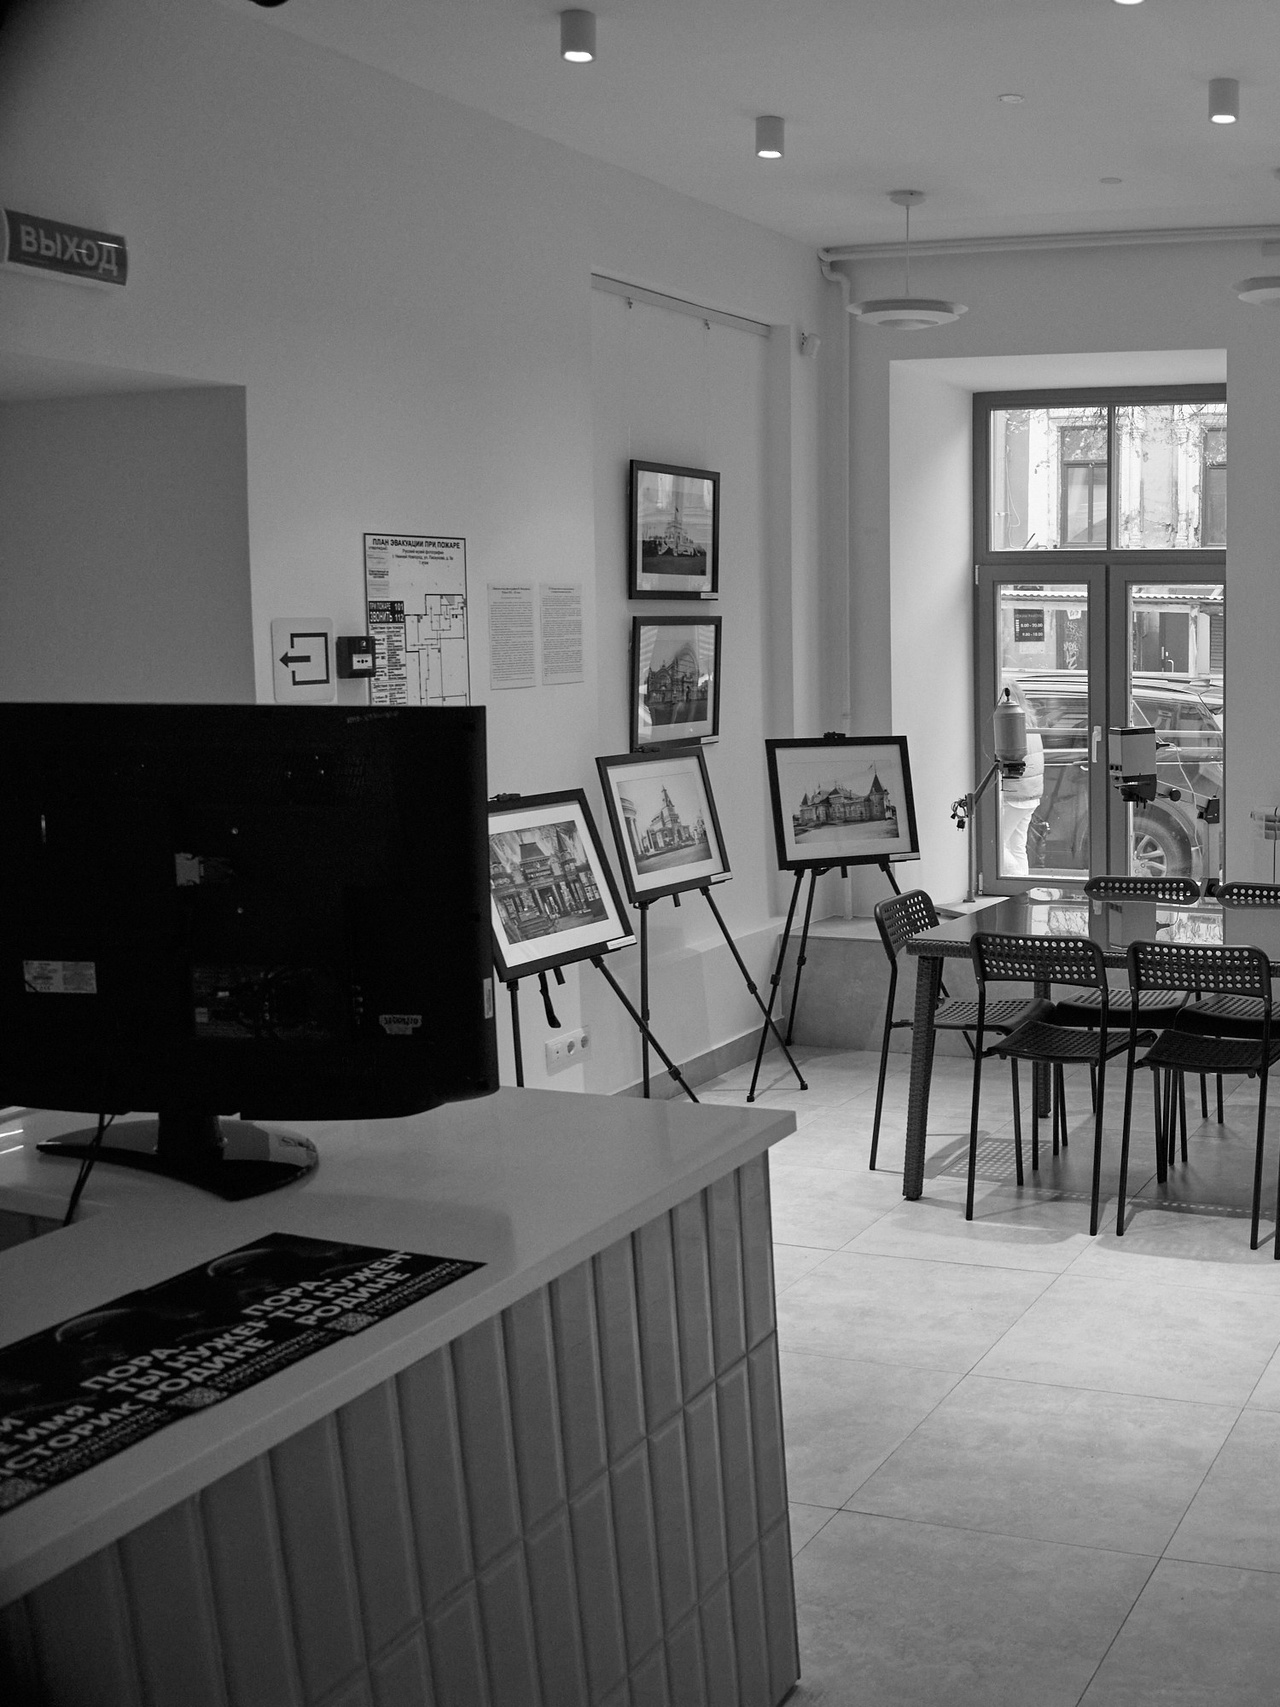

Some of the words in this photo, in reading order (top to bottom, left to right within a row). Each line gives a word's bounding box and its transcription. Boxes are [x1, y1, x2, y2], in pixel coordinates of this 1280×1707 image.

[21, 224, 118, 276] ВЫХОД
[372, 538, 389, 546] ПЛАН
[390, 539, 424, 548] ЭВАКУАЦИИ
[424, 540, 437, 548] ПРИ
[437, 541, 460, 549] ПОЖАРЕ
[370, 611, 393, 622] ЗВОНИТЬ
[394, 613, 405, 622] 112
[394, 602, 404, 611] 101
[241, 1277, 332, 1315] ПОРА.
[267, 1297, 322, 1320] ТЫ
[313, 1251, 413, 1298] НУЖЕН
[296, 1271, 412, 1326] РОДИНЕ
[80, 1345, 188, 1390] ПОРА.
[106, 1368, 171, 1393] ТЫ
[134, 1337, 275, 1402] РОДИНЕ
[15, 1403, 95, 1443] ИМЯ
